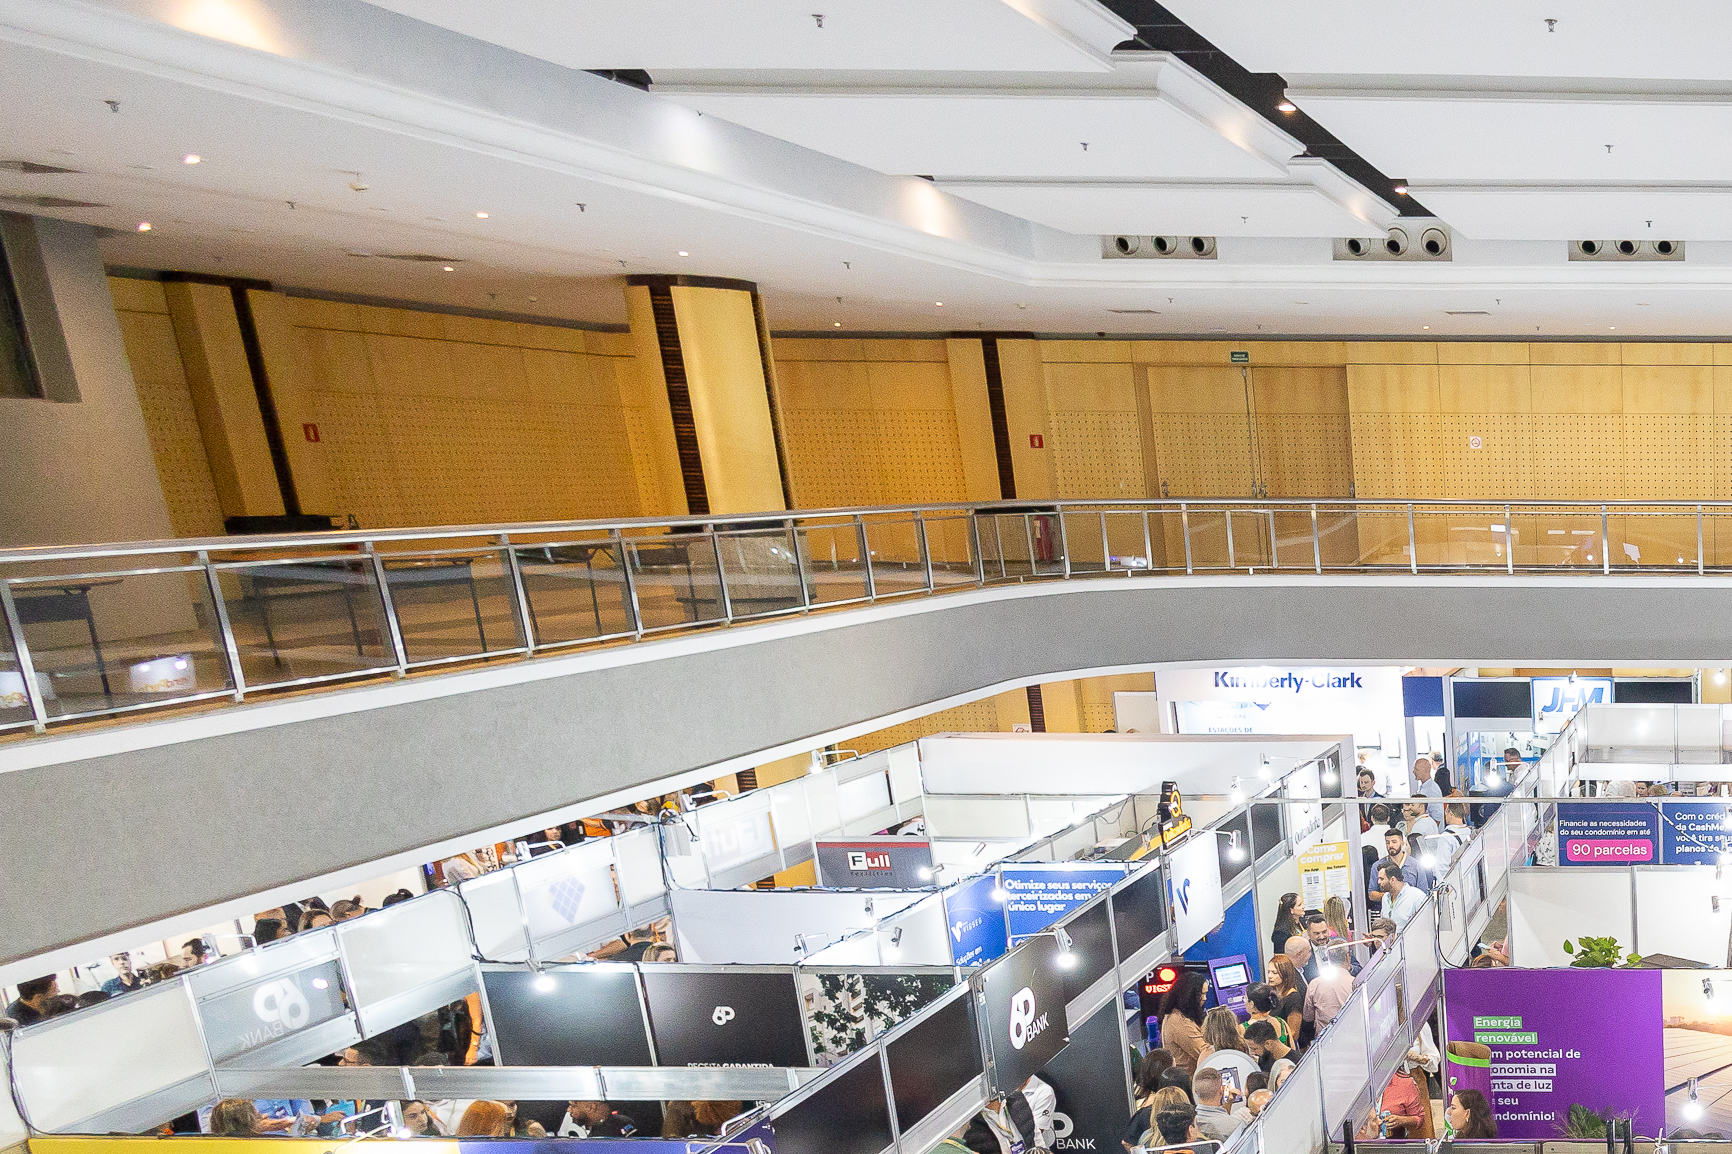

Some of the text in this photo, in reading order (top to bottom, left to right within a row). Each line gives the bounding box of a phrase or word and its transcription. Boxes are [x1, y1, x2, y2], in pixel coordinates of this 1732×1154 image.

[1542, 687, 1604, 713] JFM
[1675, 813, 1696, 821] Com
[1559, 820, 1646, 828] Financie as necessidades
[1560, 828, 1651, 836] do seu condomínio em até
[1699, 834, 1713, 842] tira
[1308, 844, 1337, 854] Como
[1572, 844, 1647, 858] 90 parcelas
[849, 853, 891, 869] Full
[1300, 852, 1345, 864] comprar
[1005, 879, 1045, 890] Otimize
[1047, 882, 1069, 890] seus
[1075, 893, 1091, 901] em
[1008, 901, 1067, 914] único lugar
[1026, 1012, 1050, 1040] BANK
[1475, 1017, 1522, 1030] Energia
[1475, 1033, 1536, 1044] renovável
[1506, 1049, 1581, 1062] potencial de
[1539, 1067, 1555, 1075] na
[1516, 1080, 1552, 1090] de luz
[1498, 1098, 1519, 1106] seu
[1493, 1110, 1555, 1121] ndomínio!
[1056, 1138, 1096, 1151] BANK
